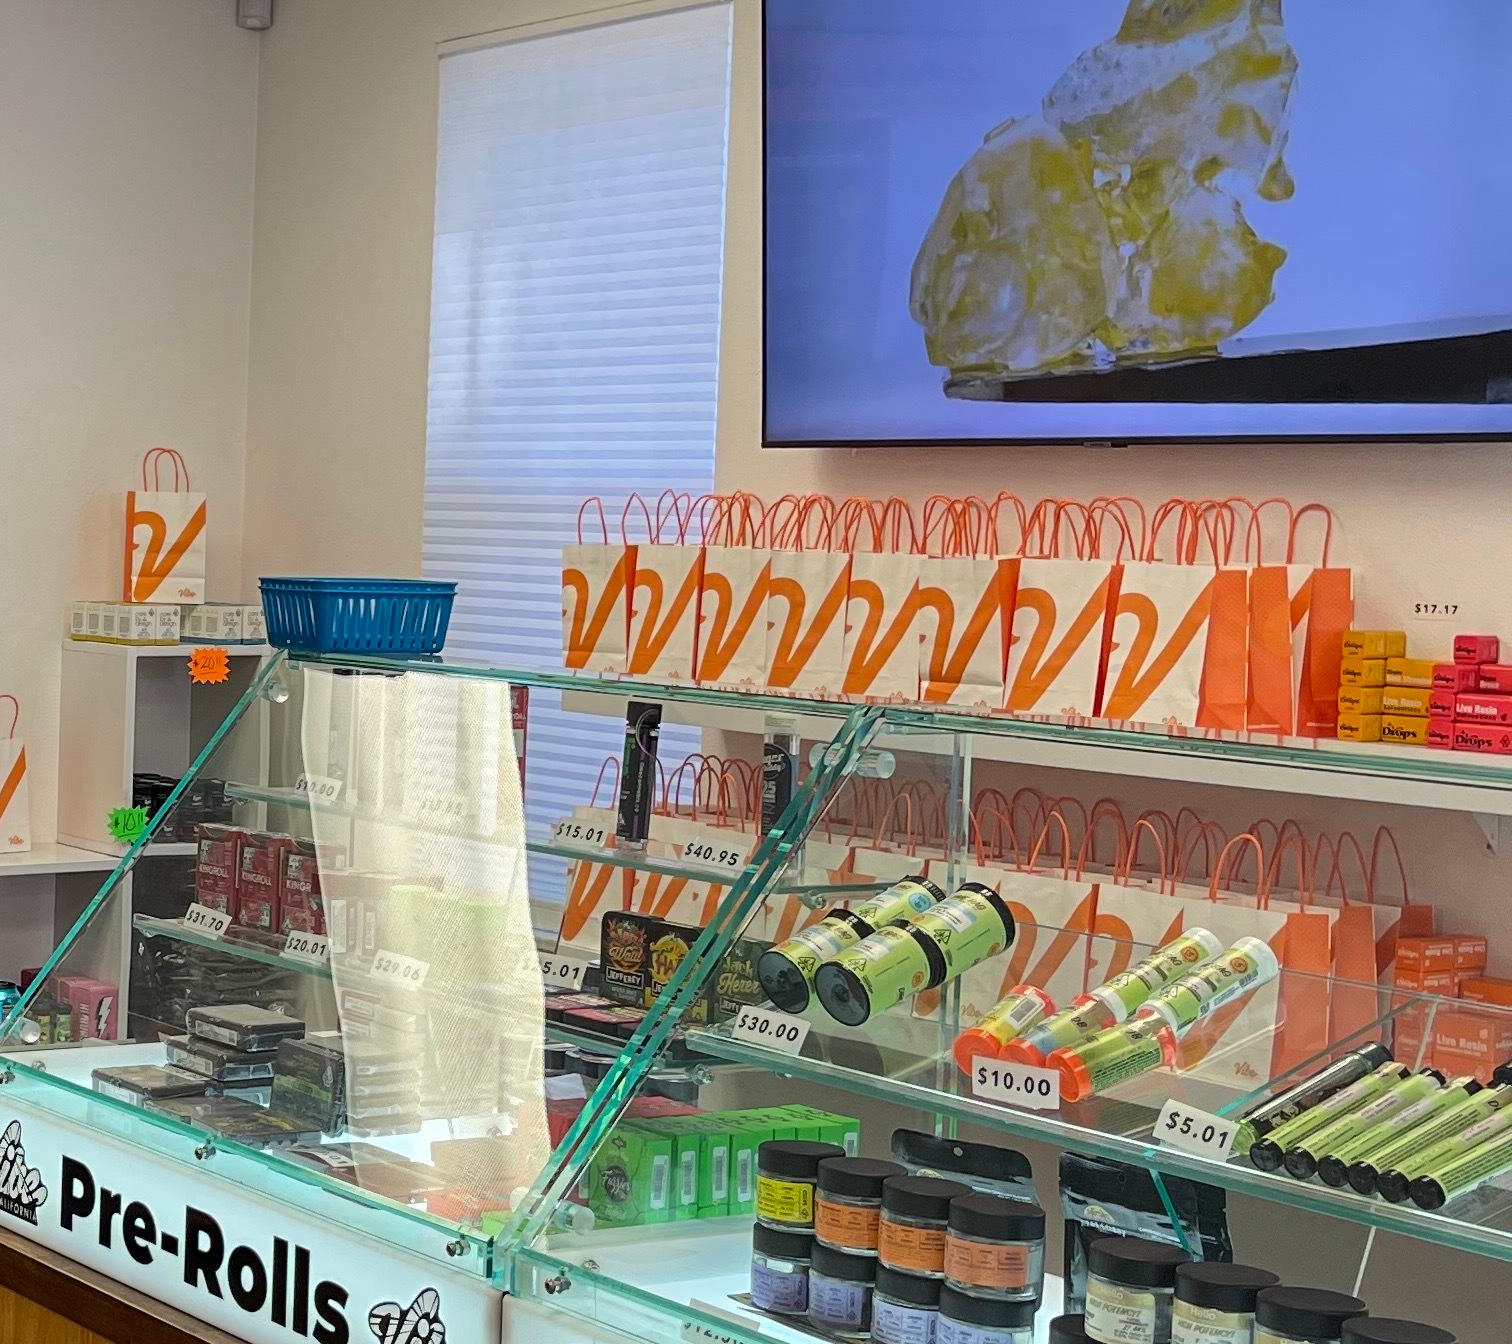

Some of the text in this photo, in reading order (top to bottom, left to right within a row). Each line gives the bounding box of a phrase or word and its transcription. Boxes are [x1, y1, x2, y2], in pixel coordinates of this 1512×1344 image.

[1415, 604, 1458, 614] $17.17
[1383, 724, 1417, 740] Drops
[1455, 732, 1493, 749] Drops
[555, 823, 604, 844] $15.01
[685, 842, 740, 866] $40.95
[186, 908, 224, 932] $31.70
[288, 935, 326, 956] $20.01
[738, 1014, 799, 1041] $30.00
[978, 1067, 1051, 1096] $10.00
[1166, 1111, 1229, 1149] $5.01
